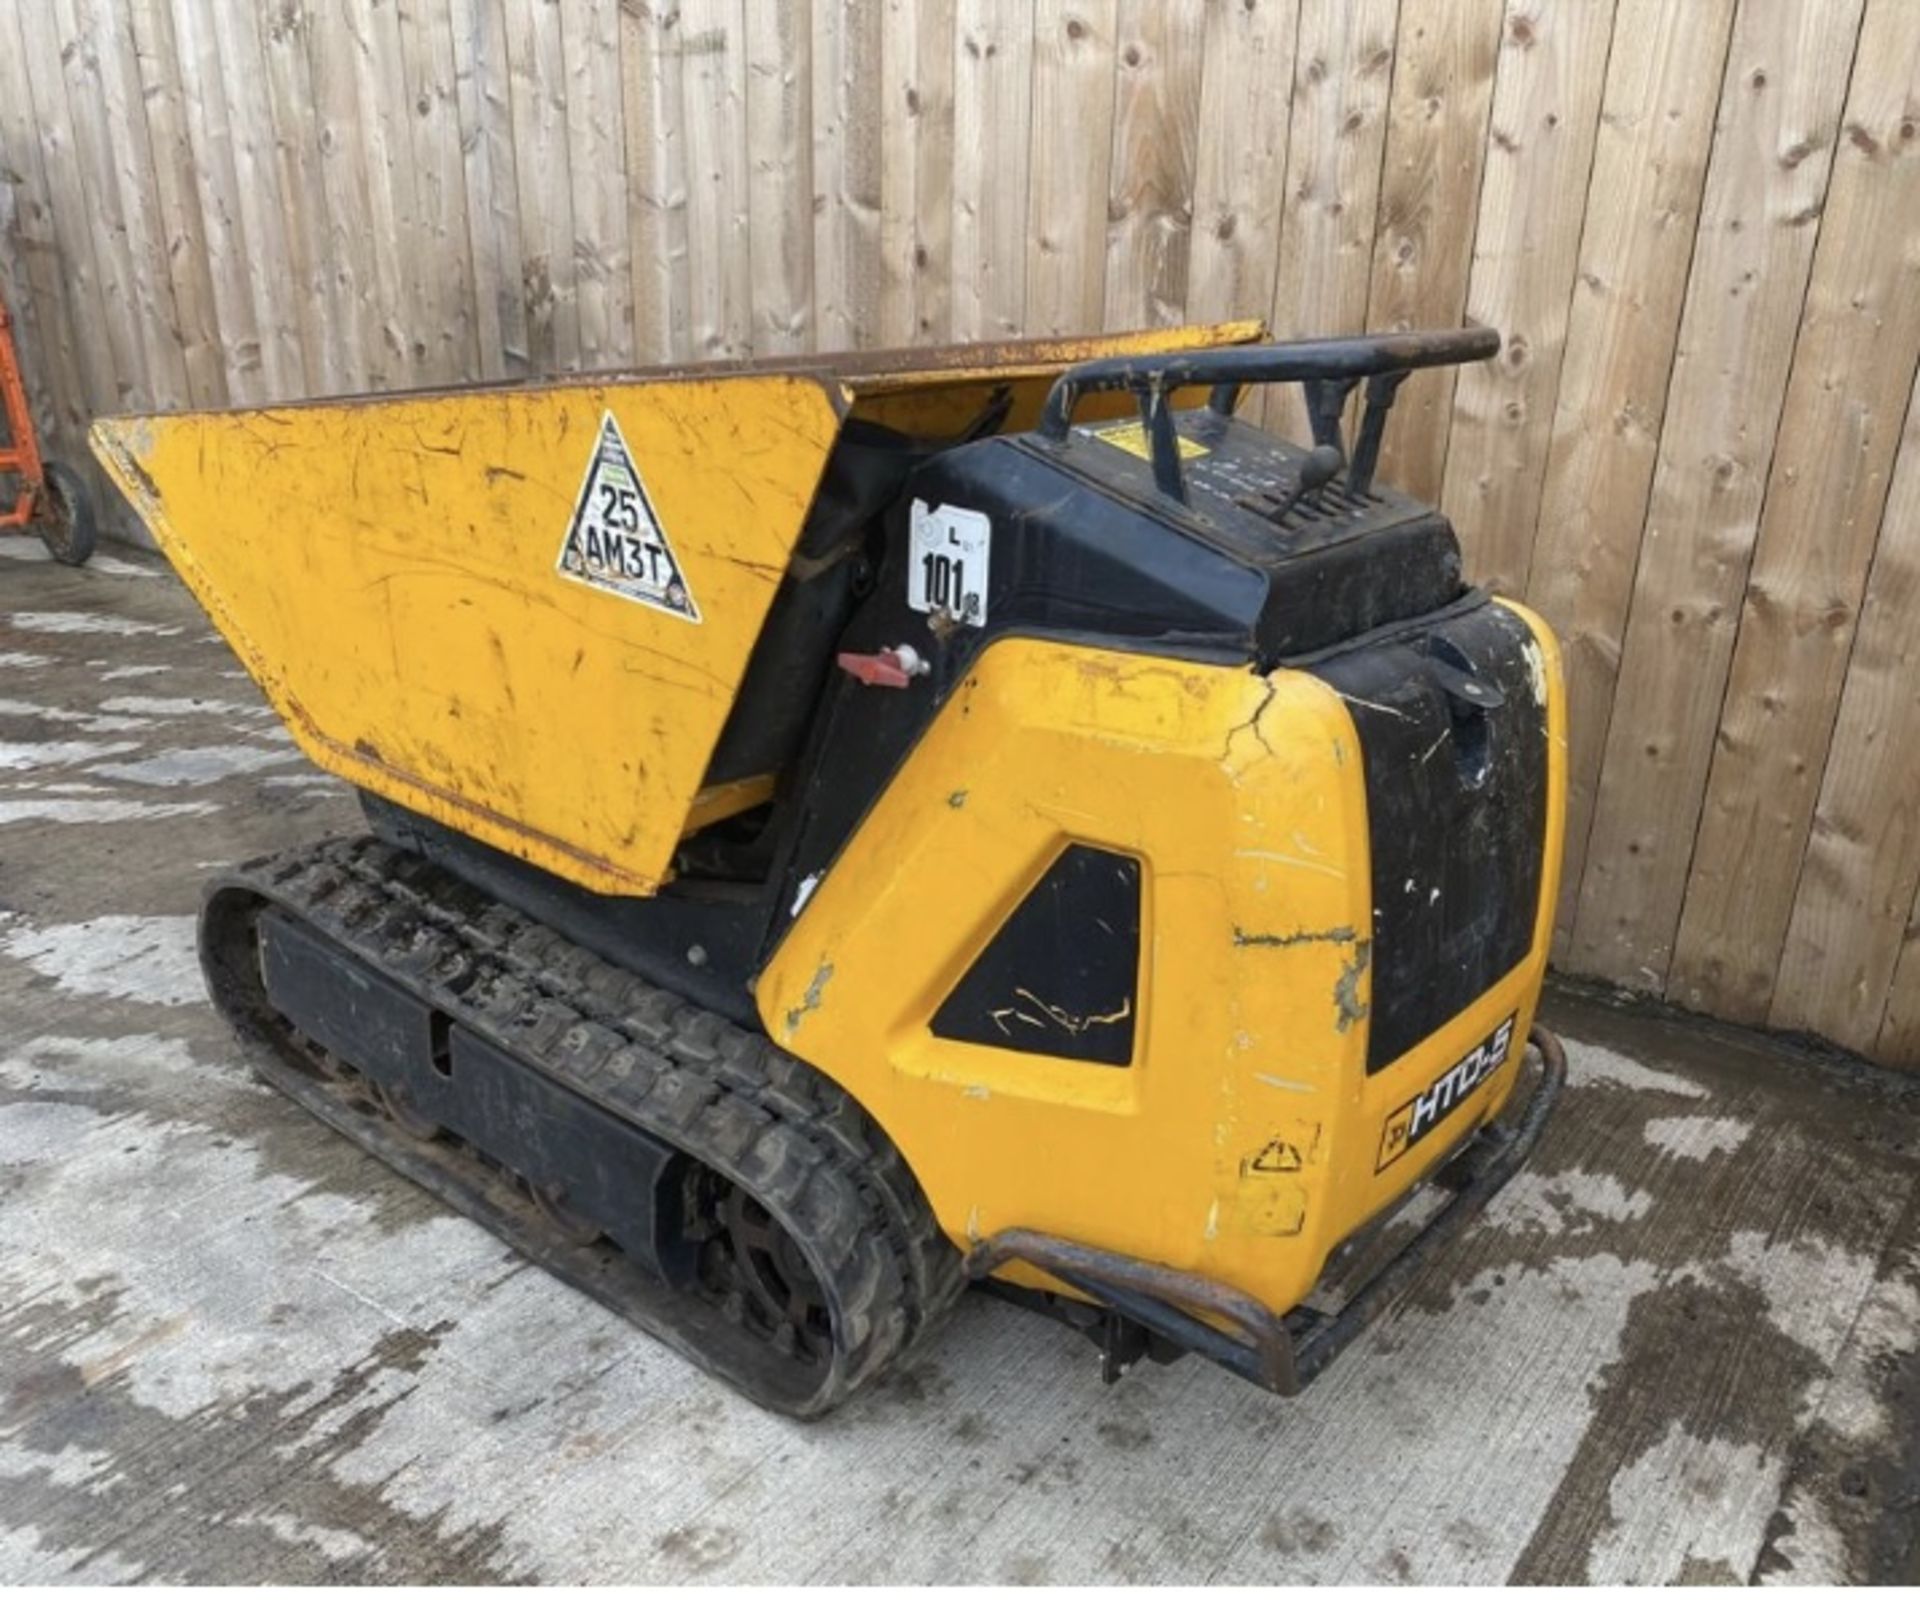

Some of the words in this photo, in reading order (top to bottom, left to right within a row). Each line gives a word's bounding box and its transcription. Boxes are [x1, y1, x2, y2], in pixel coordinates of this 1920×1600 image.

[601, 484, 638, 534] 25
[586, 525, 662, 582] AM3T
[949, 526, 960, 546] L
[922, 552, 963, 611] 101
